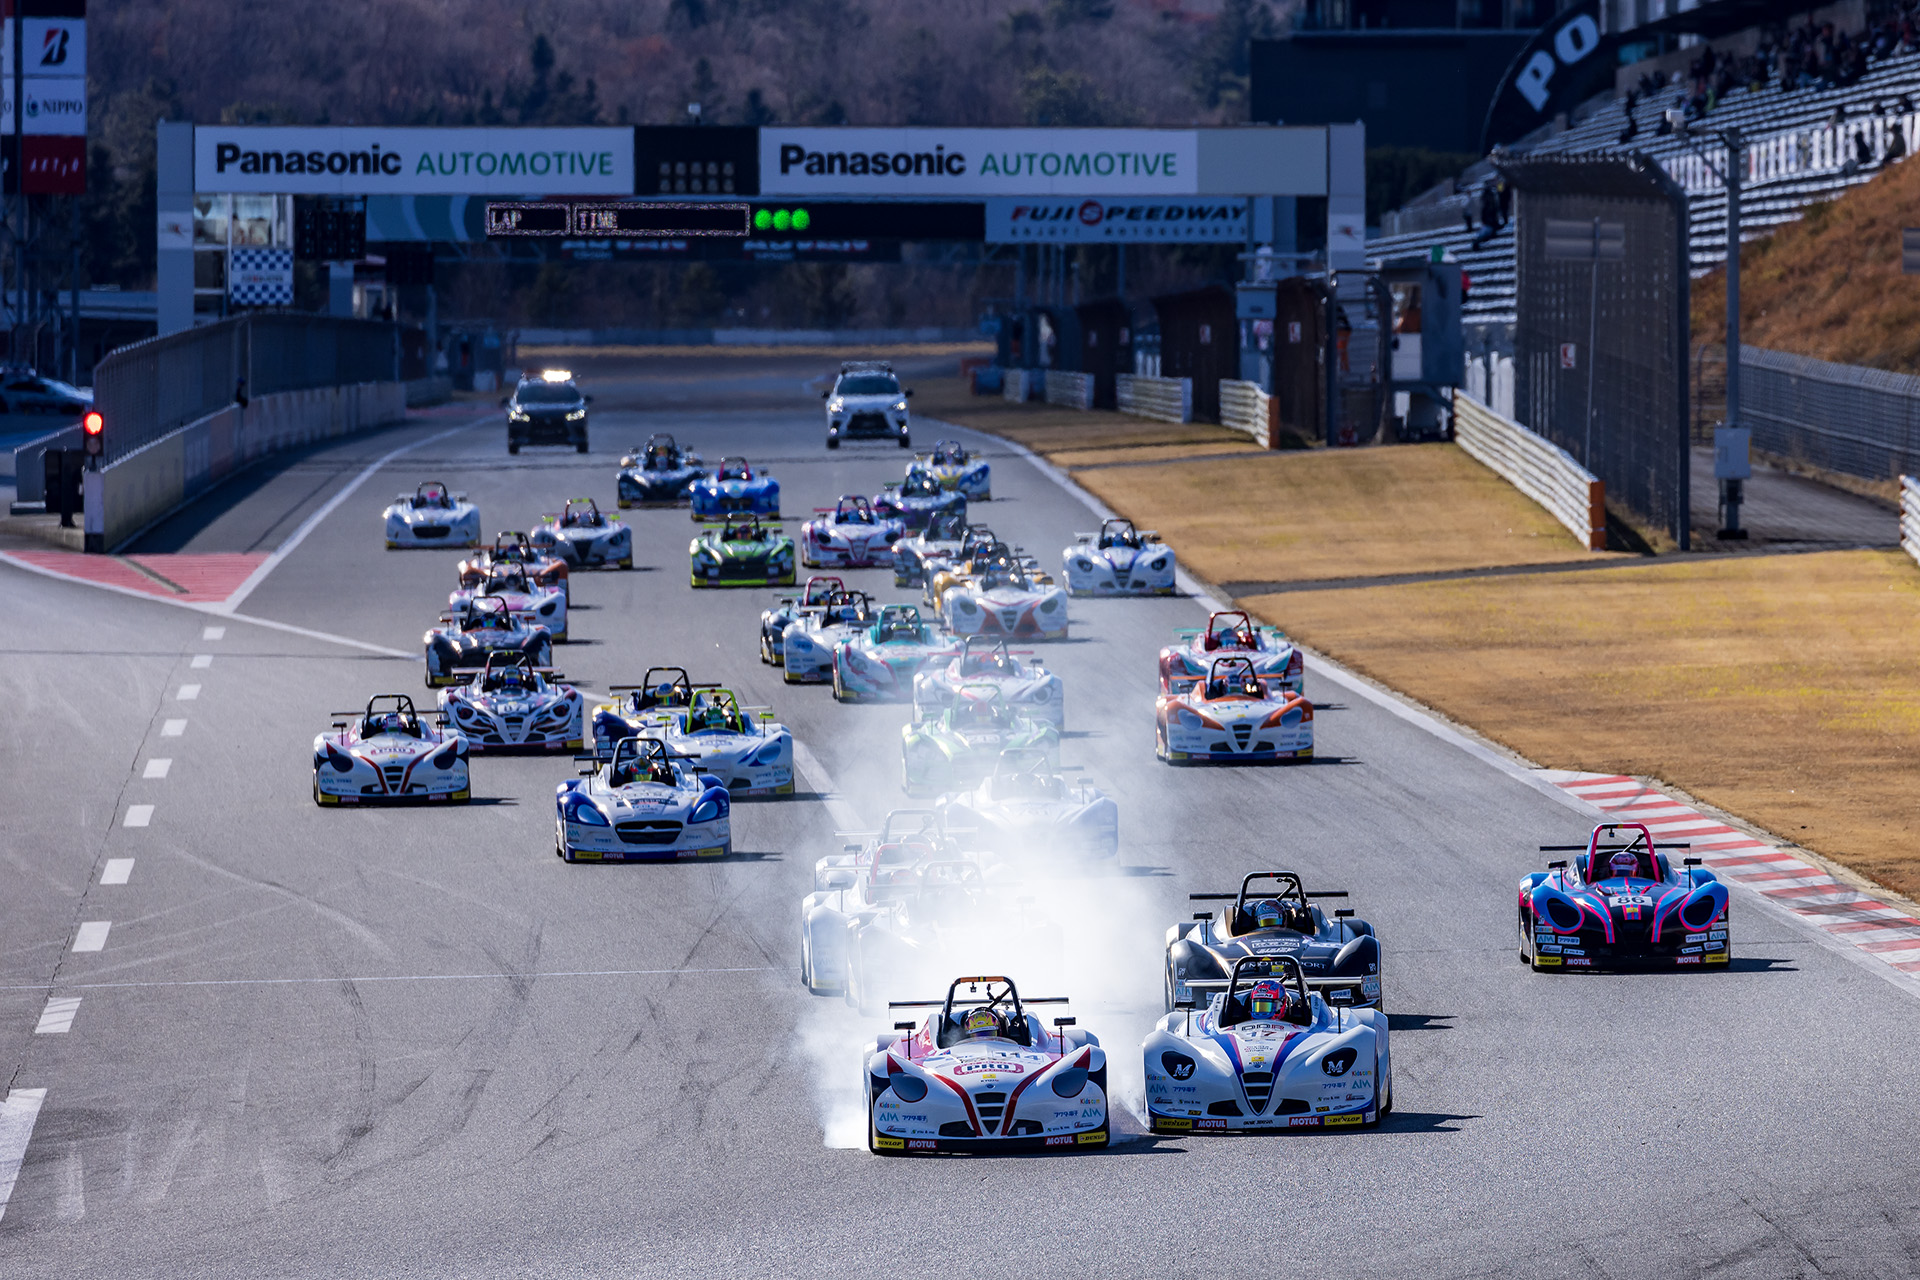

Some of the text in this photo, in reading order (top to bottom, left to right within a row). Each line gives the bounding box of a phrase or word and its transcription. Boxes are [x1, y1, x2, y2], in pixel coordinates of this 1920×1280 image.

[42, 100, 83, 114] NIPPO
[216, 142, 614, 176] Panasonic AUTOMOTIVE
[780, 144, 1178, 176] Panasonic AUTOMOTIVE
[1010, 200, 1247, 226] FUJI SPEEDWAY
[490, 210, 522, 229] LAP
[578, 211, 619, 229] TIME
[1617, 896, 1645, 904] 86
[1248, 961, 1327, 969] MOTORPORT
[1677, 956, 1700, 964] MOTUL
[1149, 1083, 1167, 1093] AIM
[1352, 1079, 1372, 1089] AIM
[879, 1112, 899, 1122] AIM
[1082, 1108, 1102, 1118] AIM
[1197, 1120, 1226, 1128] MOTUL
[1290, 1117, 1319, 1126] MOTUL
[1332, 1115, 1361, 1123] DUNLOP
[909, 1140, 937, 1148] MOTUL
[1046, 1135, 1074, 1145] MOTUL
